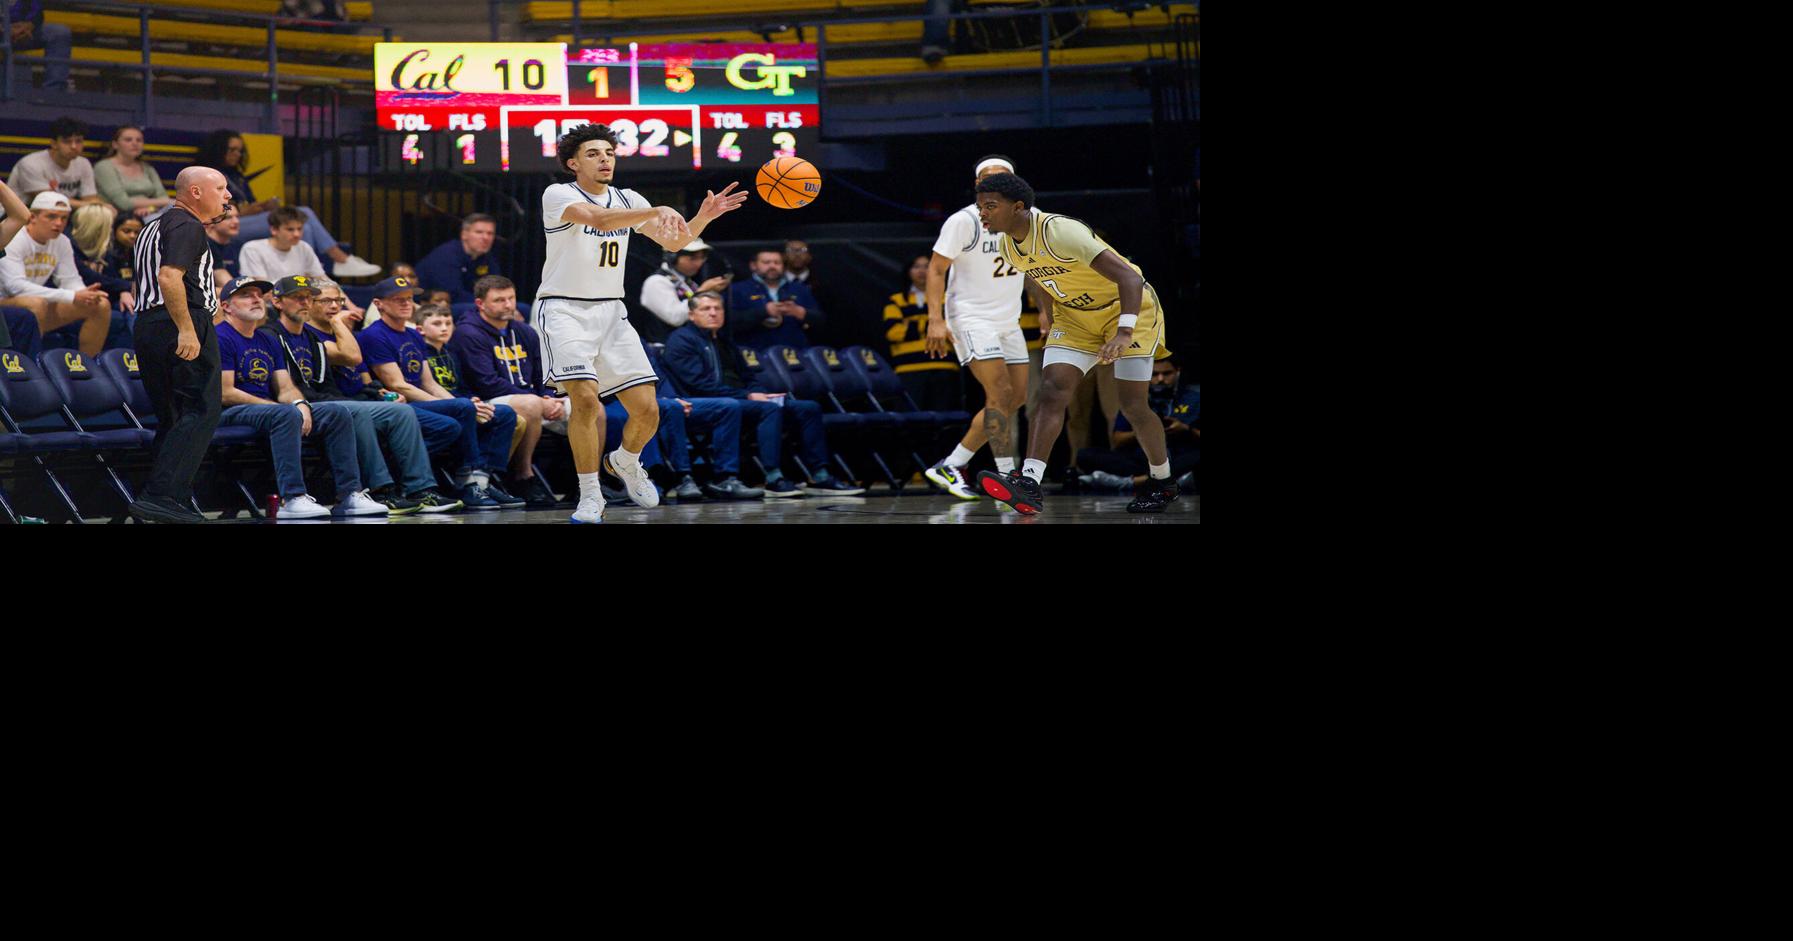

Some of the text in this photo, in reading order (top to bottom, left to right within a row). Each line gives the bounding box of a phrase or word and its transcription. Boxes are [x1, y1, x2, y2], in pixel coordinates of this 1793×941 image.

[391, 49, 464, 99] Cal
[495, 59, 544, 90] 10
[587, 67, 609, 98] 1
[665, 57, 695, 93] 5
[725, 53, 806, 96] GT
[391, 114, 486, 131] TOL FLS
[709, 112, 802, 129] TOL FLS
[456, 134, 475, 164] 1
[772, 132, 796, 158] 3
[599, 241, 619, 267] 10
[1041, 279, 1068, 298] 7
[2, 353, 25, 372] Cal
[65, 352, 87, 371] Cal
